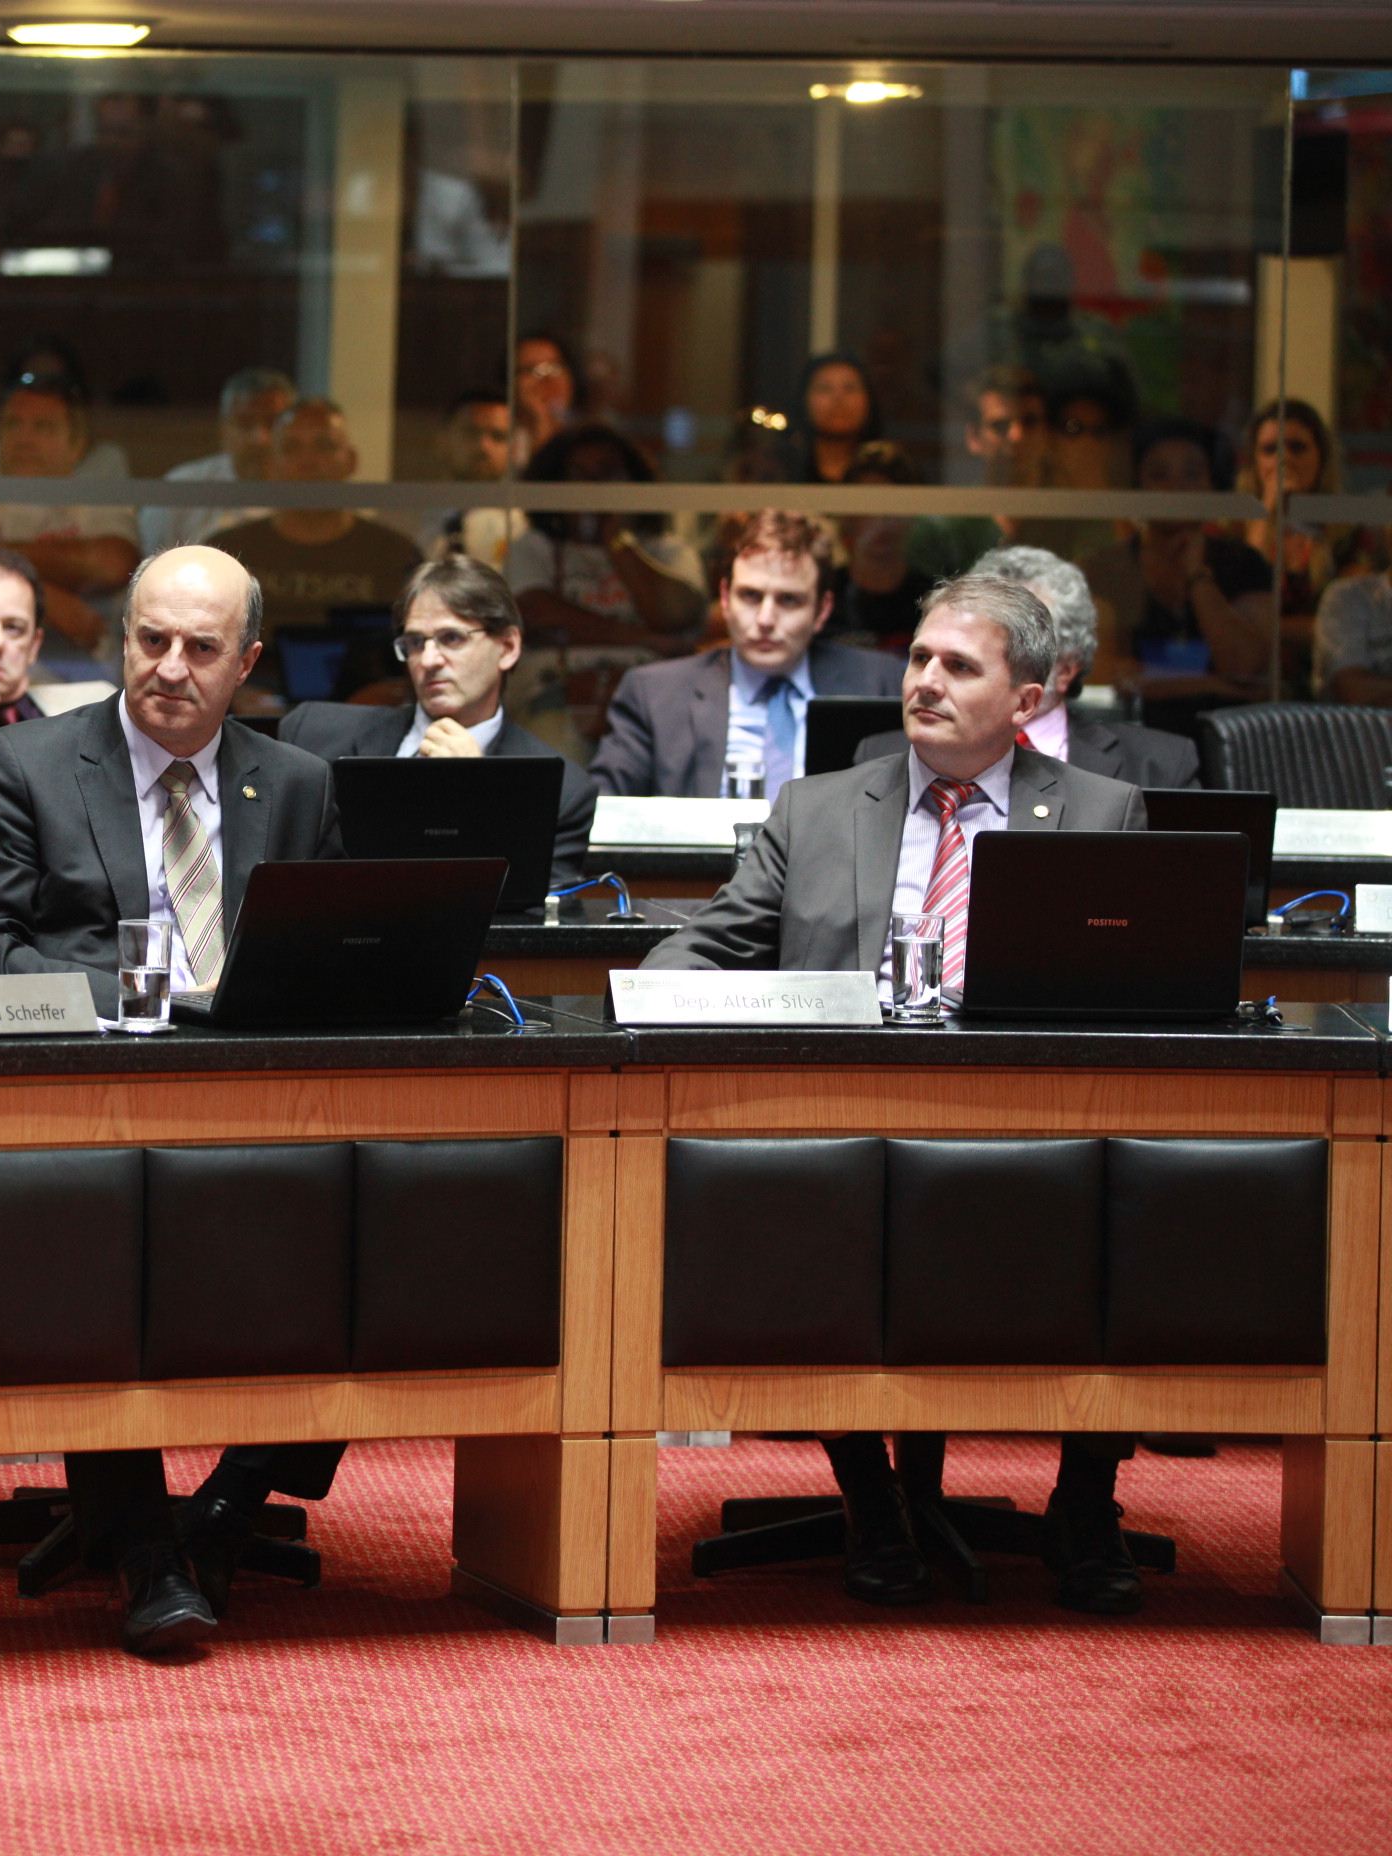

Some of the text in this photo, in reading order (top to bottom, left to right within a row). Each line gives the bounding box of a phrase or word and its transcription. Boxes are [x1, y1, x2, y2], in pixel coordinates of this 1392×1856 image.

[1087, 918, 1128, 927] POSITIVO
[6, 1003, 66, 1021] Scheffer
[673, 994, 825, 1012] Dep. Altair Silva
